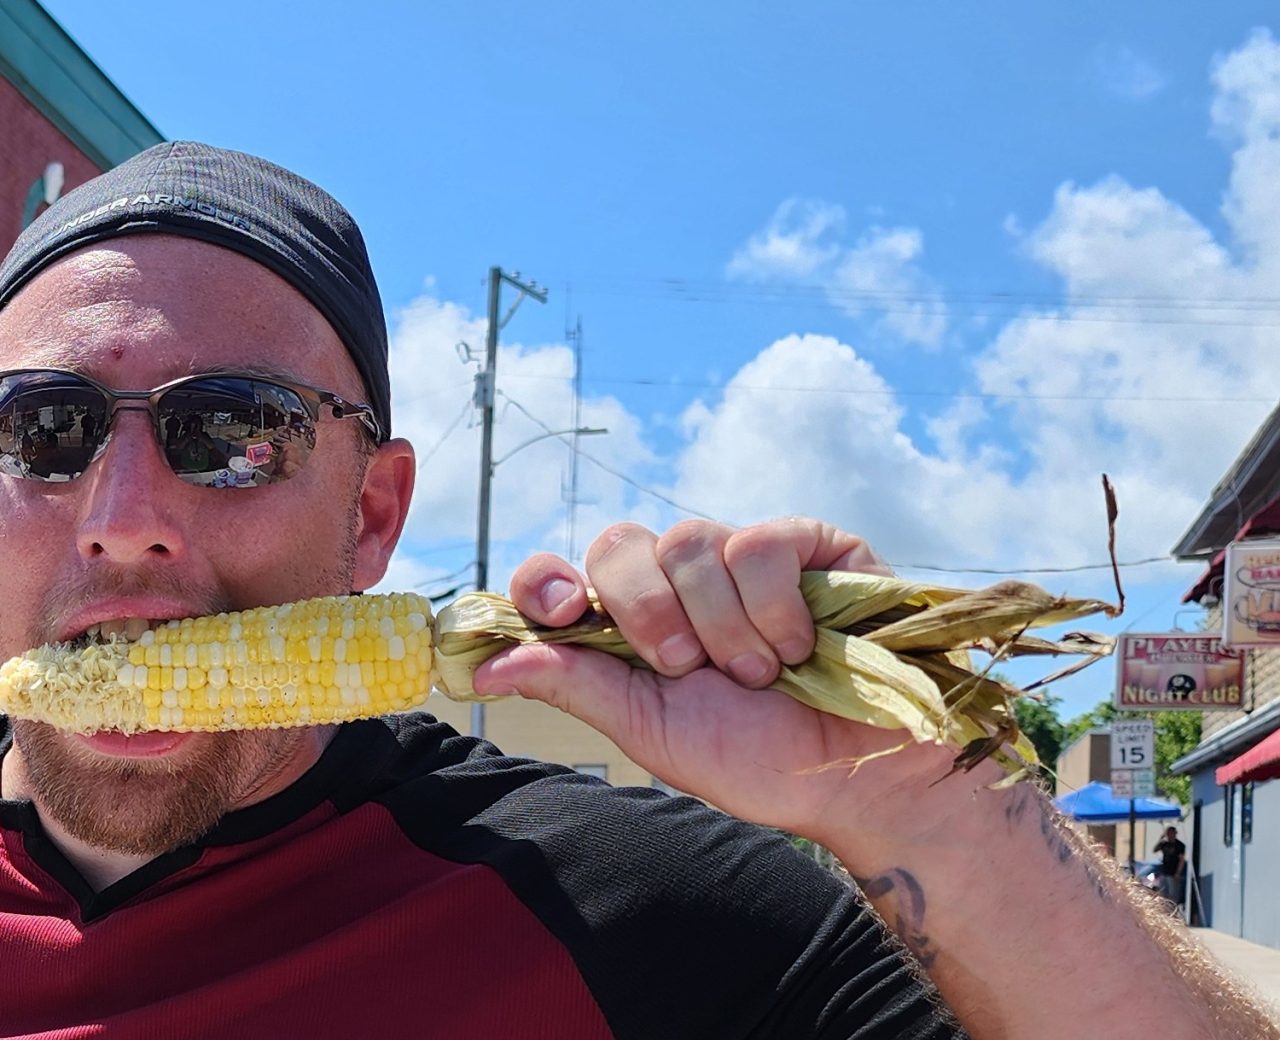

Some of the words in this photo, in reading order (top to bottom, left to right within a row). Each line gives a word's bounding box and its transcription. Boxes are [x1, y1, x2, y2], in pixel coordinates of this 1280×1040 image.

[47, 197, 128, 240] UNDER
[131, 194, 251, 231] ARMOUR
[1123, 684, 1183, 704] NIGHT
[1187, 684, 1240, 704] CLUB
[1121, 747, 1145, 764] 15
